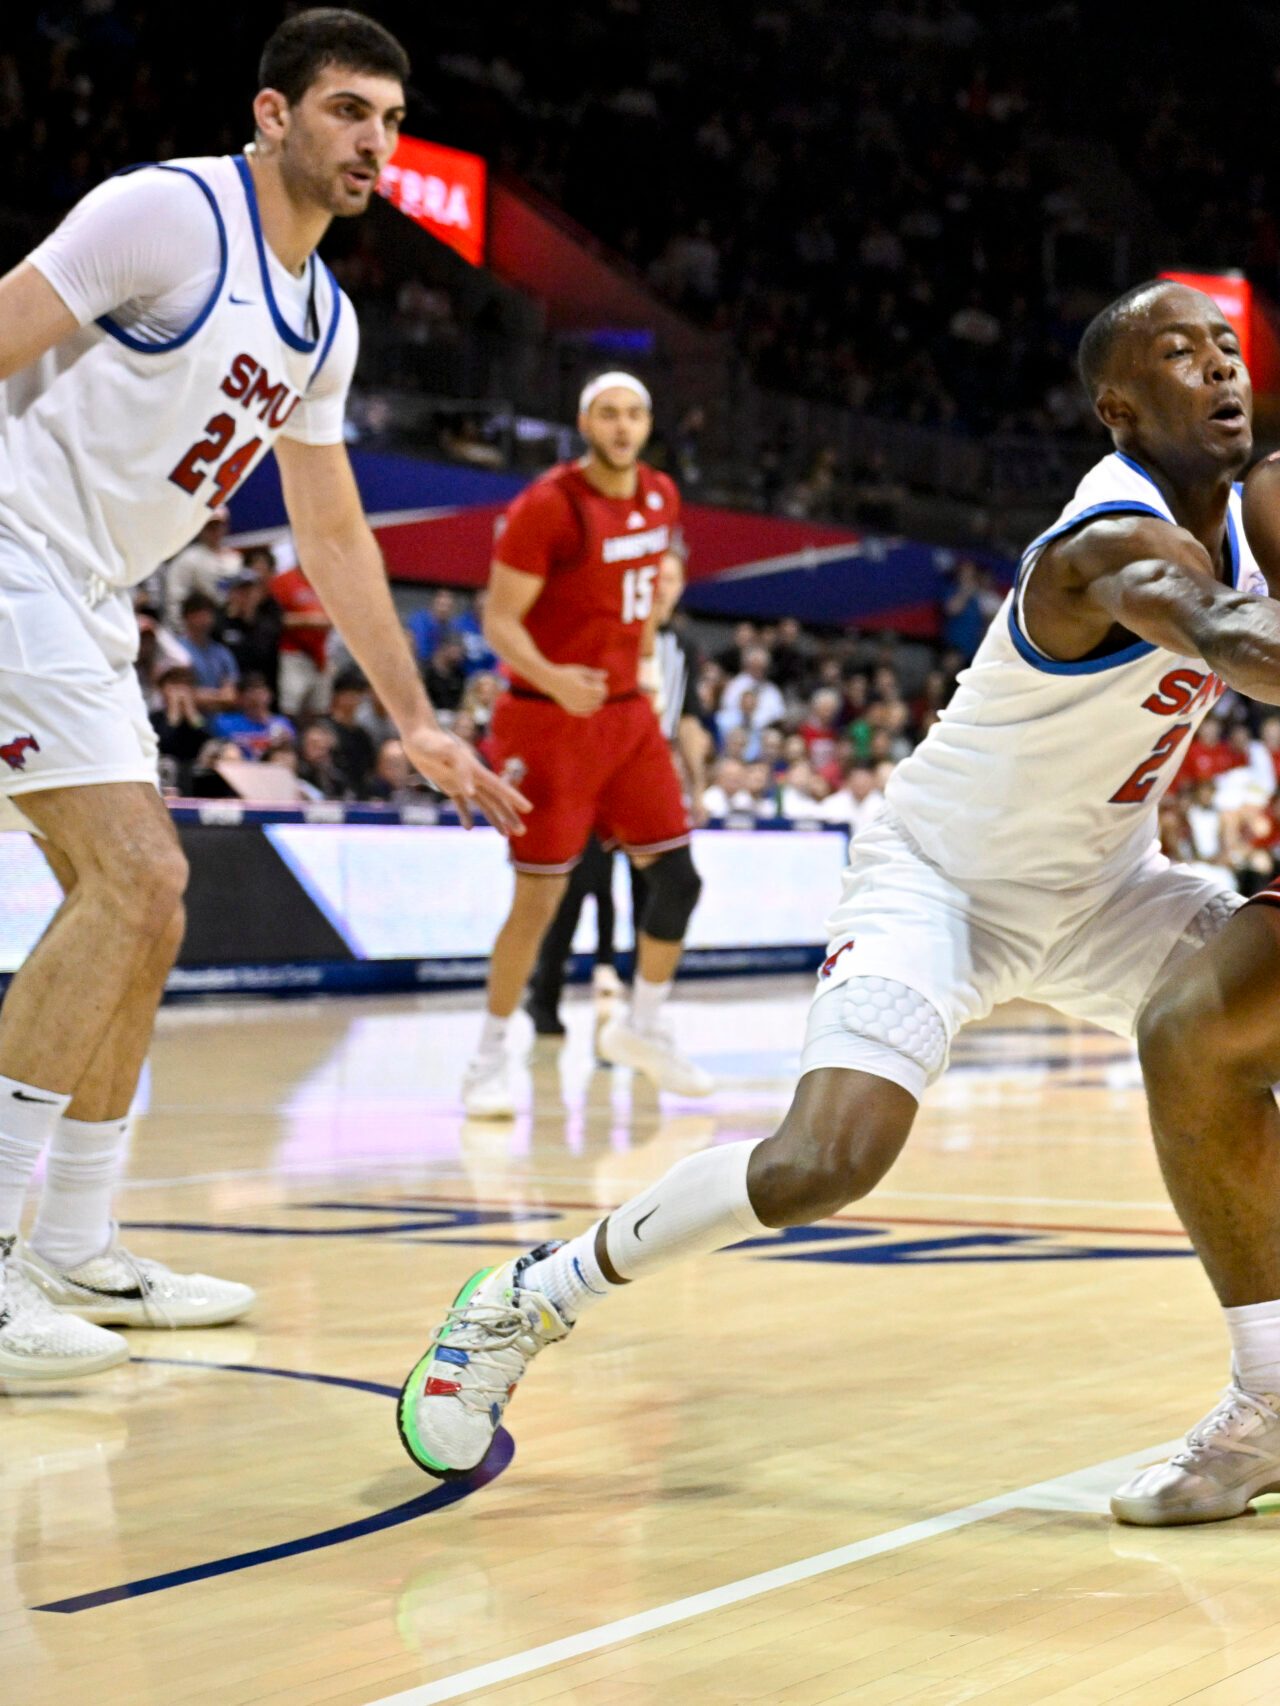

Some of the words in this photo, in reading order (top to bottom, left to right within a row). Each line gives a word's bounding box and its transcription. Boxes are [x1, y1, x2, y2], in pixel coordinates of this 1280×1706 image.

[220, 353, 302, 429] SMU
[168, 412, 262, 509] 24
[621, 565, 654, 624] 15
[1108, 722, 1192, 803] 2
